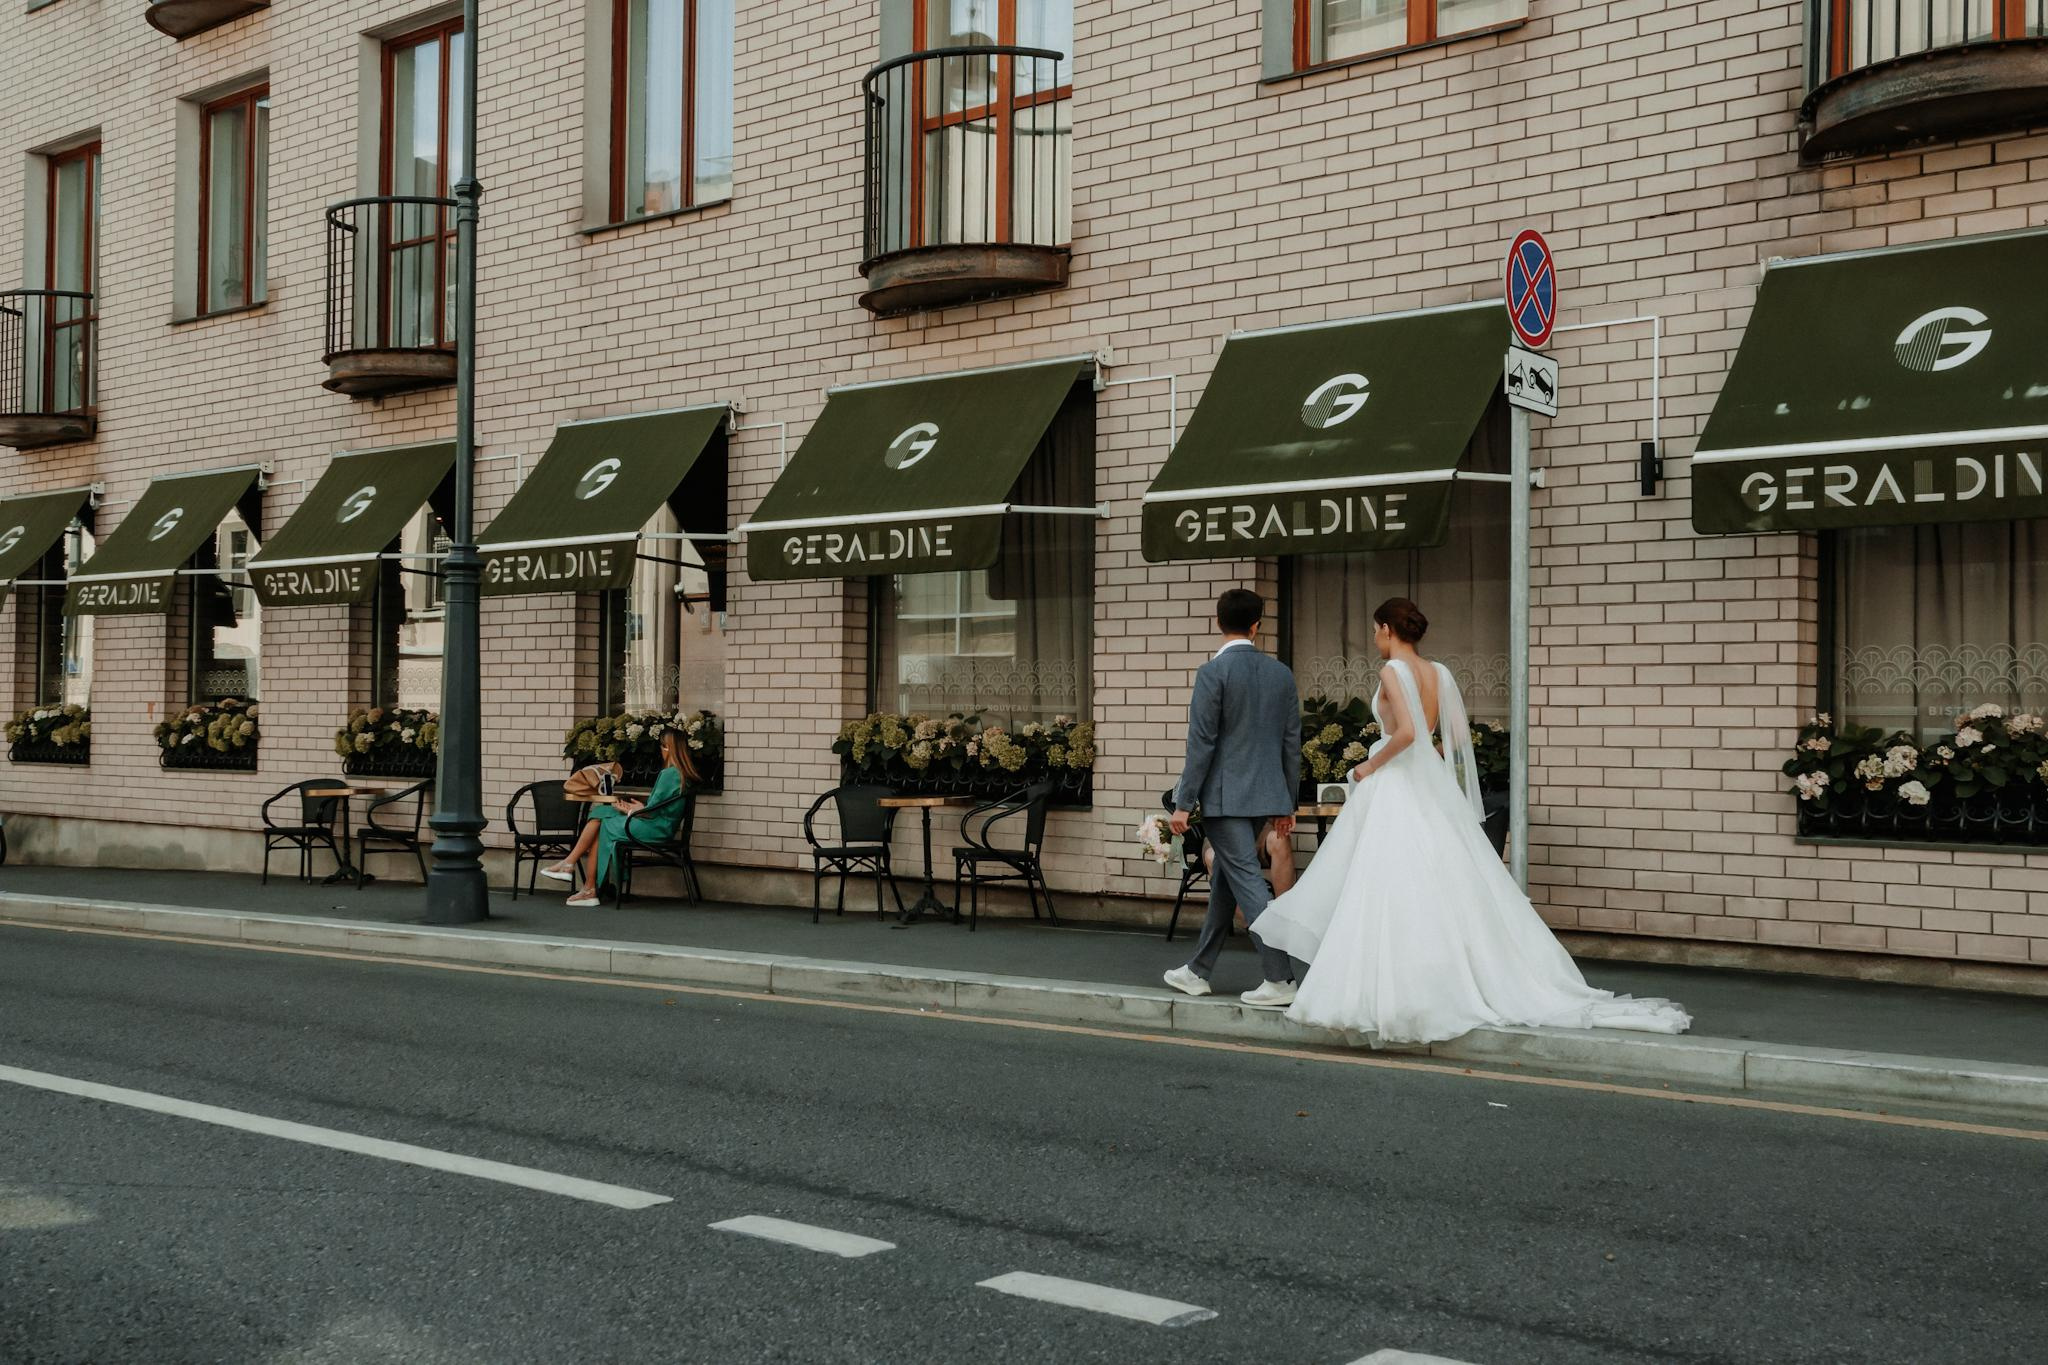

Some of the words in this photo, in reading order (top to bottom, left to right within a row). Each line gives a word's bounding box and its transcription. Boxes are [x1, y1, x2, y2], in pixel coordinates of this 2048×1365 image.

[1175, 494, 1408, 543] GERALDINE
[783, 525, 953, 566] GERALDINE
[485, 549, 613, 584] GERALDINE
[77, 582, 161, 606] GERALDINE
[264, 567, 362, 596] GERALDINE
[987, 704, 1029, 712] NOUVEAU
[1928, 706, 1975, 716] BISTR
